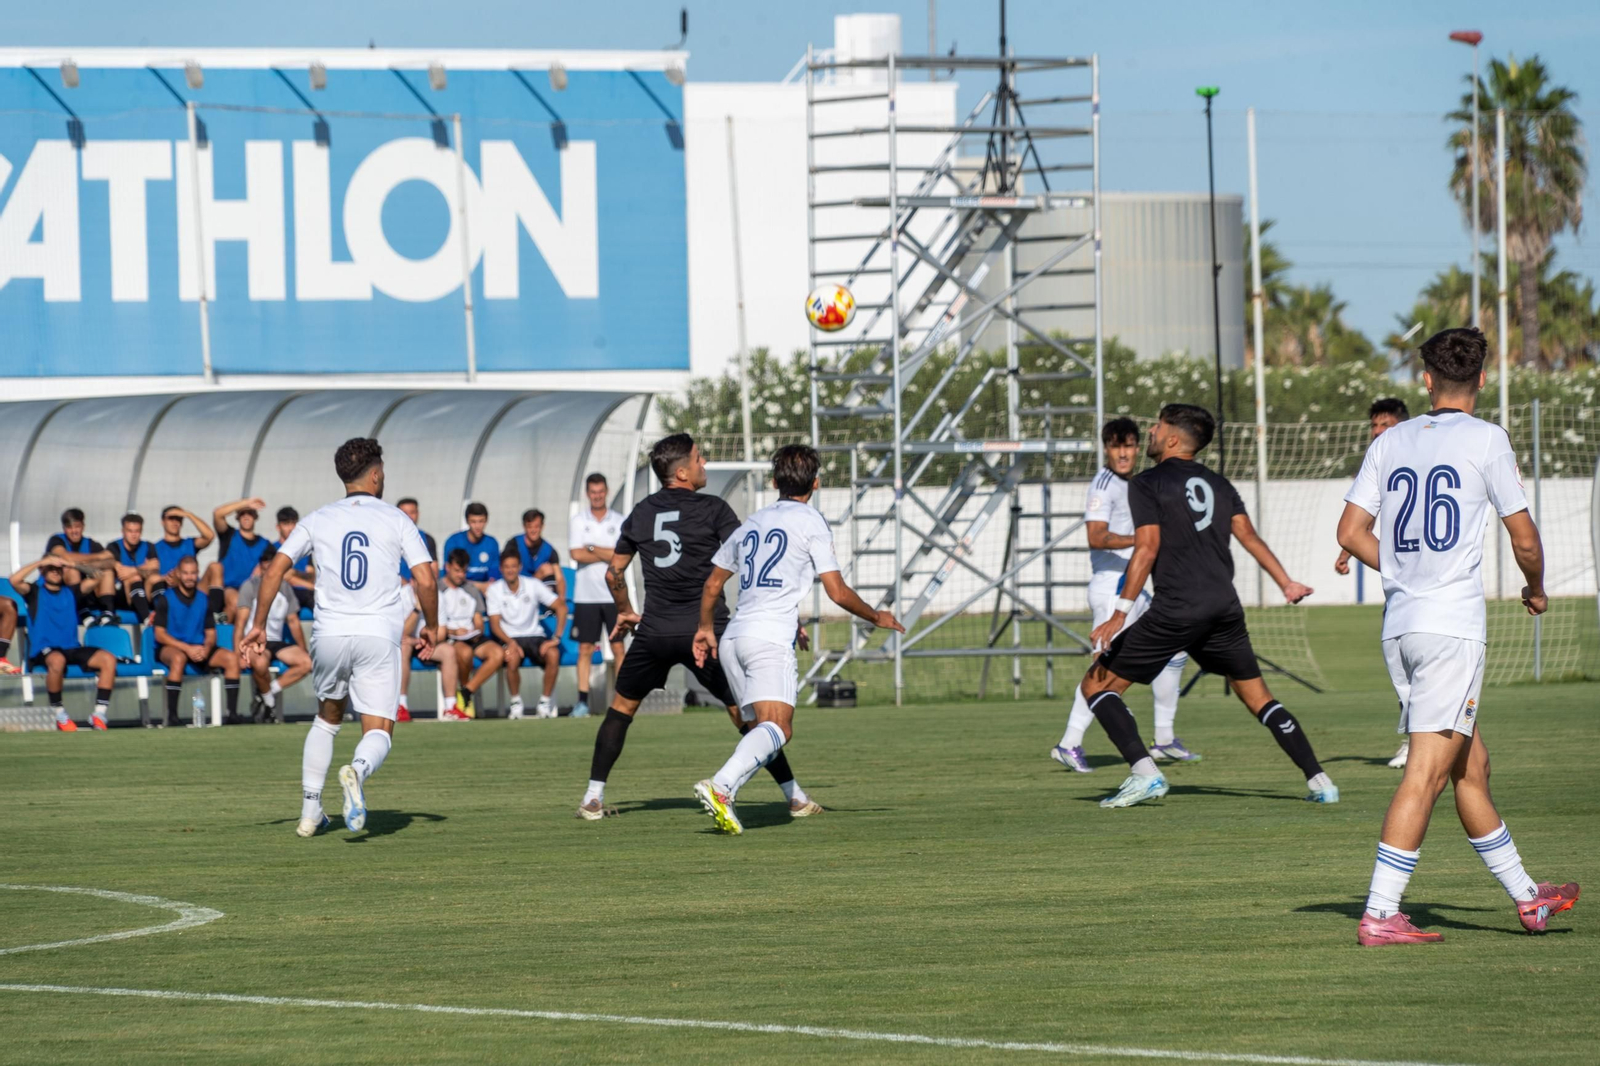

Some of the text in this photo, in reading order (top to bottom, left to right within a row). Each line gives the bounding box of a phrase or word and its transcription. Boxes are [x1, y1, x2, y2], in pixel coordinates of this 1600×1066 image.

[0, 137, 598, 303] ATHLON
[1185, 476, 1215, 531] 9
[1387, 464, 1460, 553] 26
[341, 531, 370, 590] 6
[653, 511, 682, 569] 5
[740, 527, 789, 590] 32
